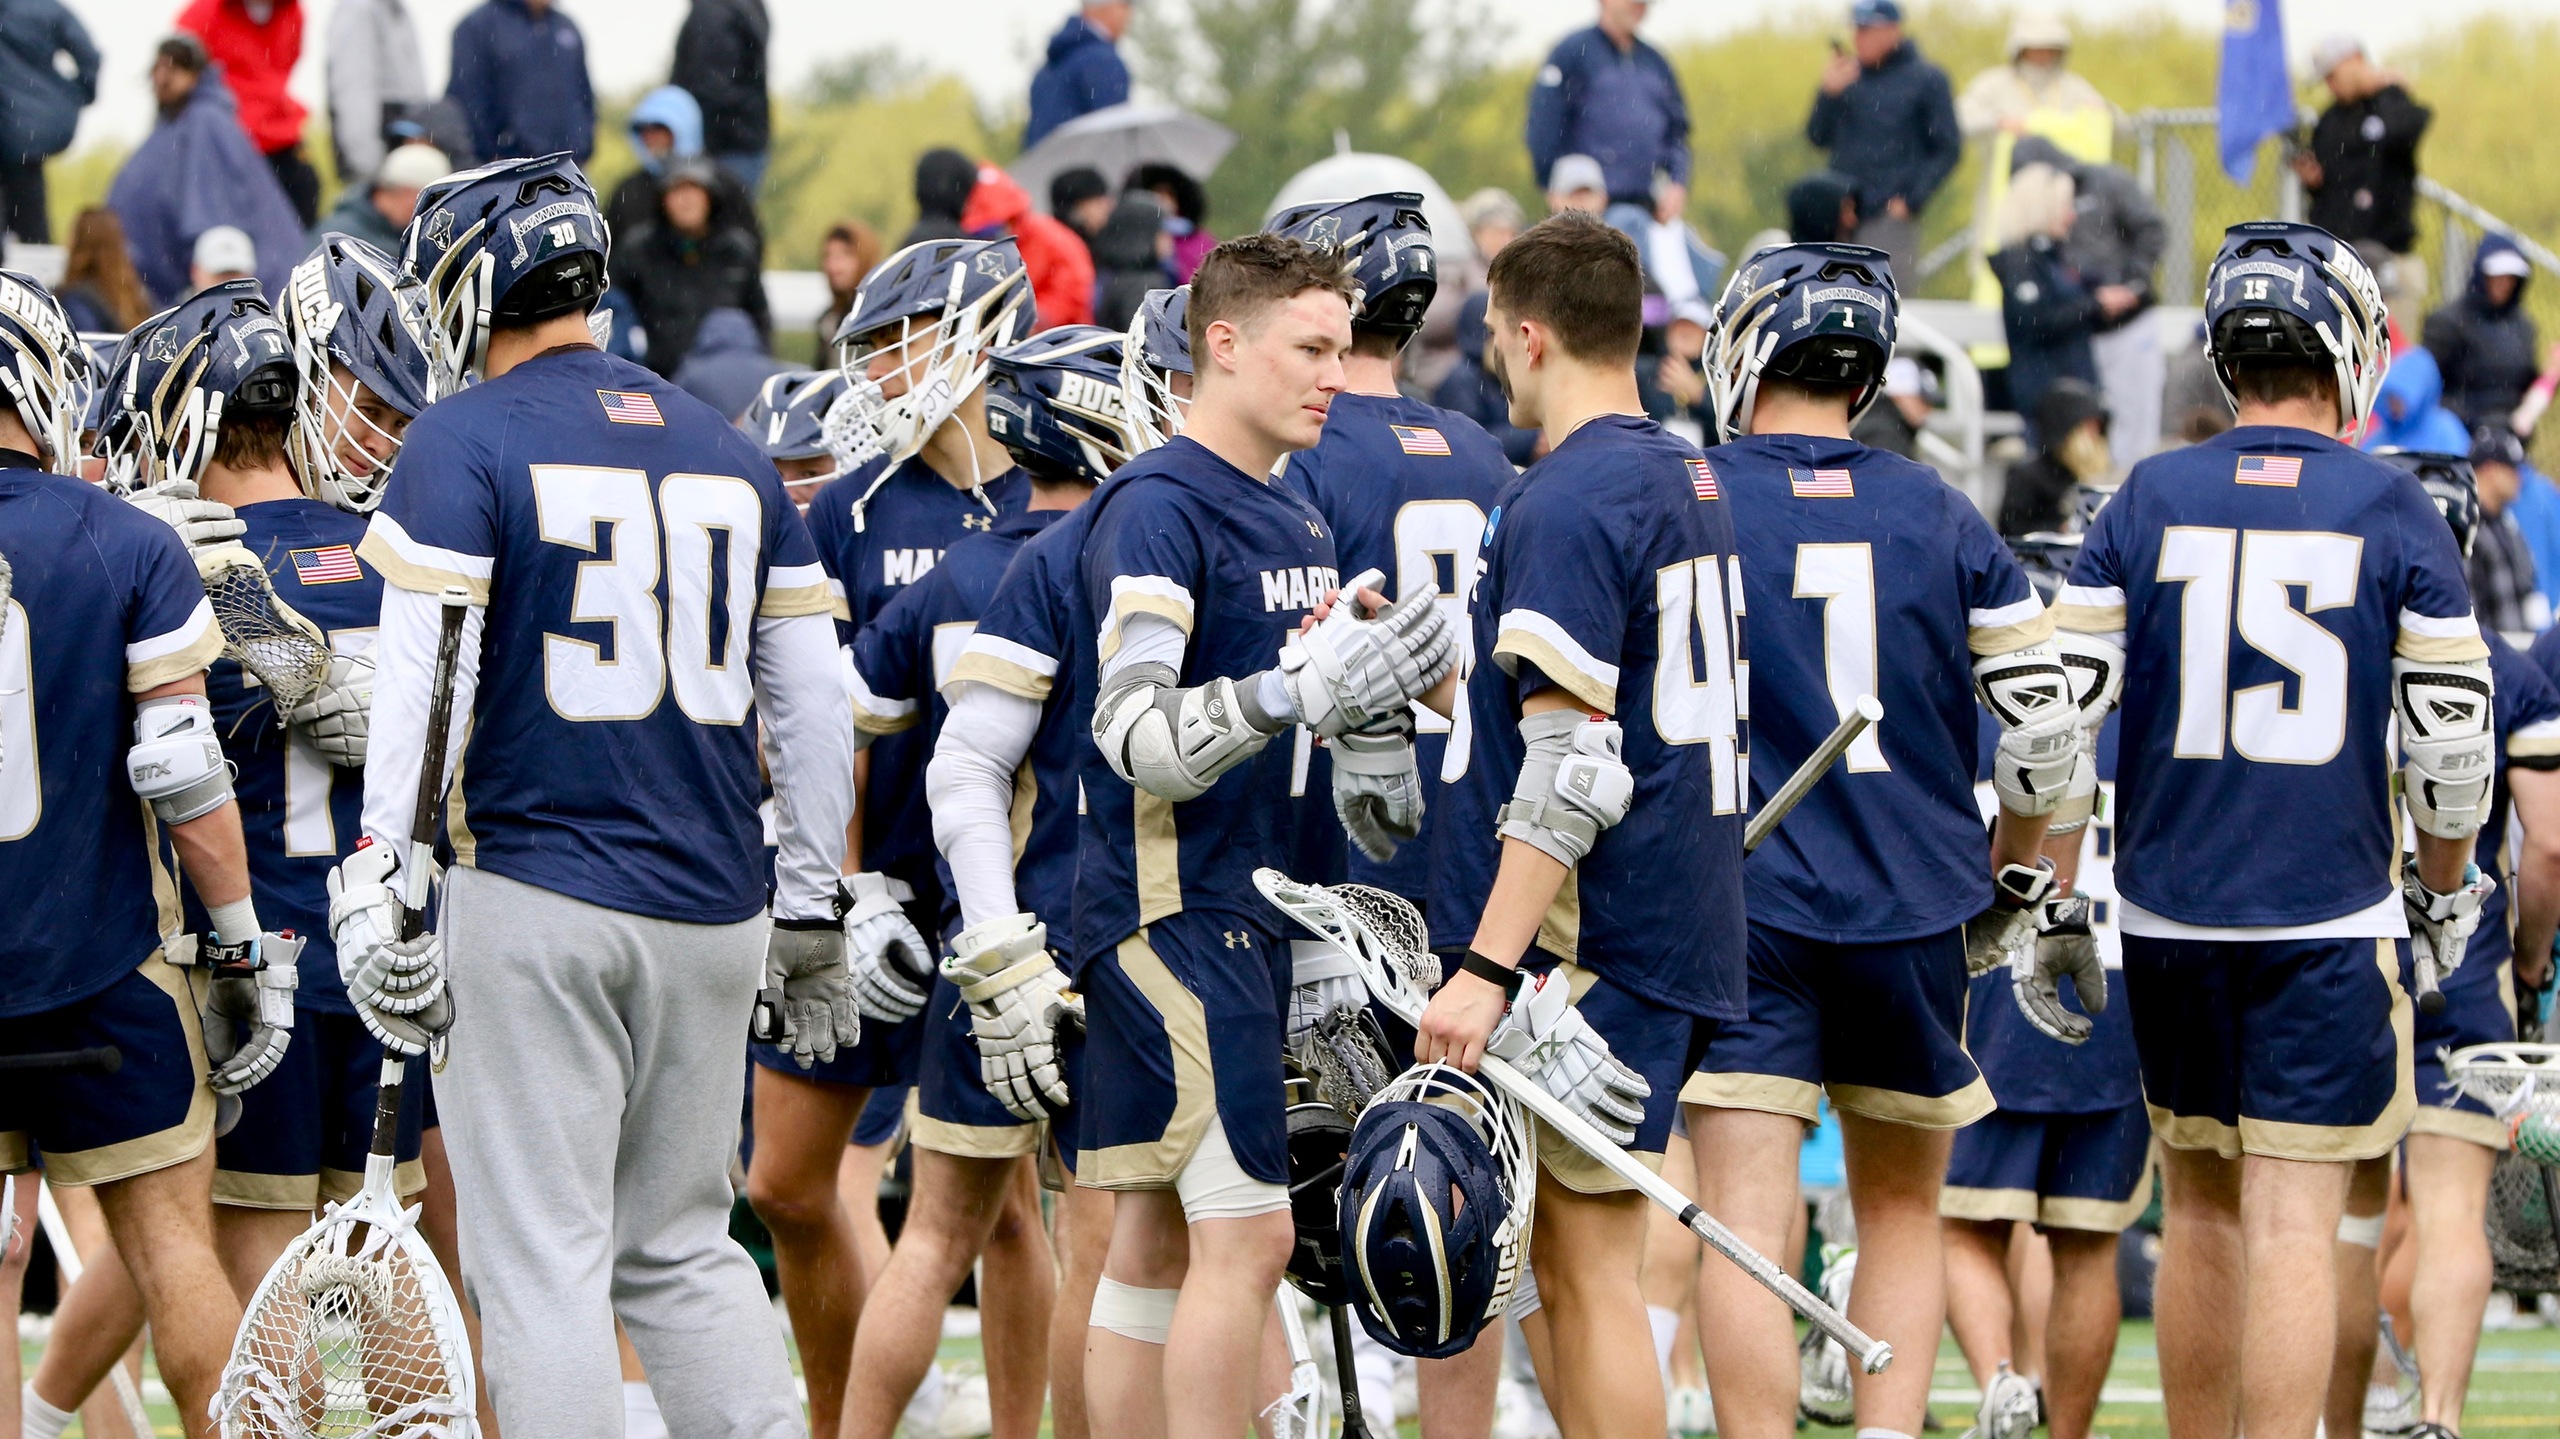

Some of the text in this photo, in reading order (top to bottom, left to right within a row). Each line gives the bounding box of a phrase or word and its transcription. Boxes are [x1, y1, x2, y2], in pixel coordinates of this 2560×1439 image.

[548, 221, 577, 248] 30
[2244, 223, 2289, 231] cascade
[2244, 279, 2269, 300] 15
[0, 275, 64, 352] BUCS
[1842, 306, 1855, 328] 1
[263, 332, 285, 354] 17
[883, 548, 946, 587] MA
[528, 463, 763, 728] 30
[1792, 542, 1892, 774] 1
[2155, 525, 2365, 766] 15
[2029, 722, 2080, 755] STX
[133, 757, 173, 783] STX
[2438, 744, 2488, 771] STX
[1577, 769, 1591, 790] 1K
